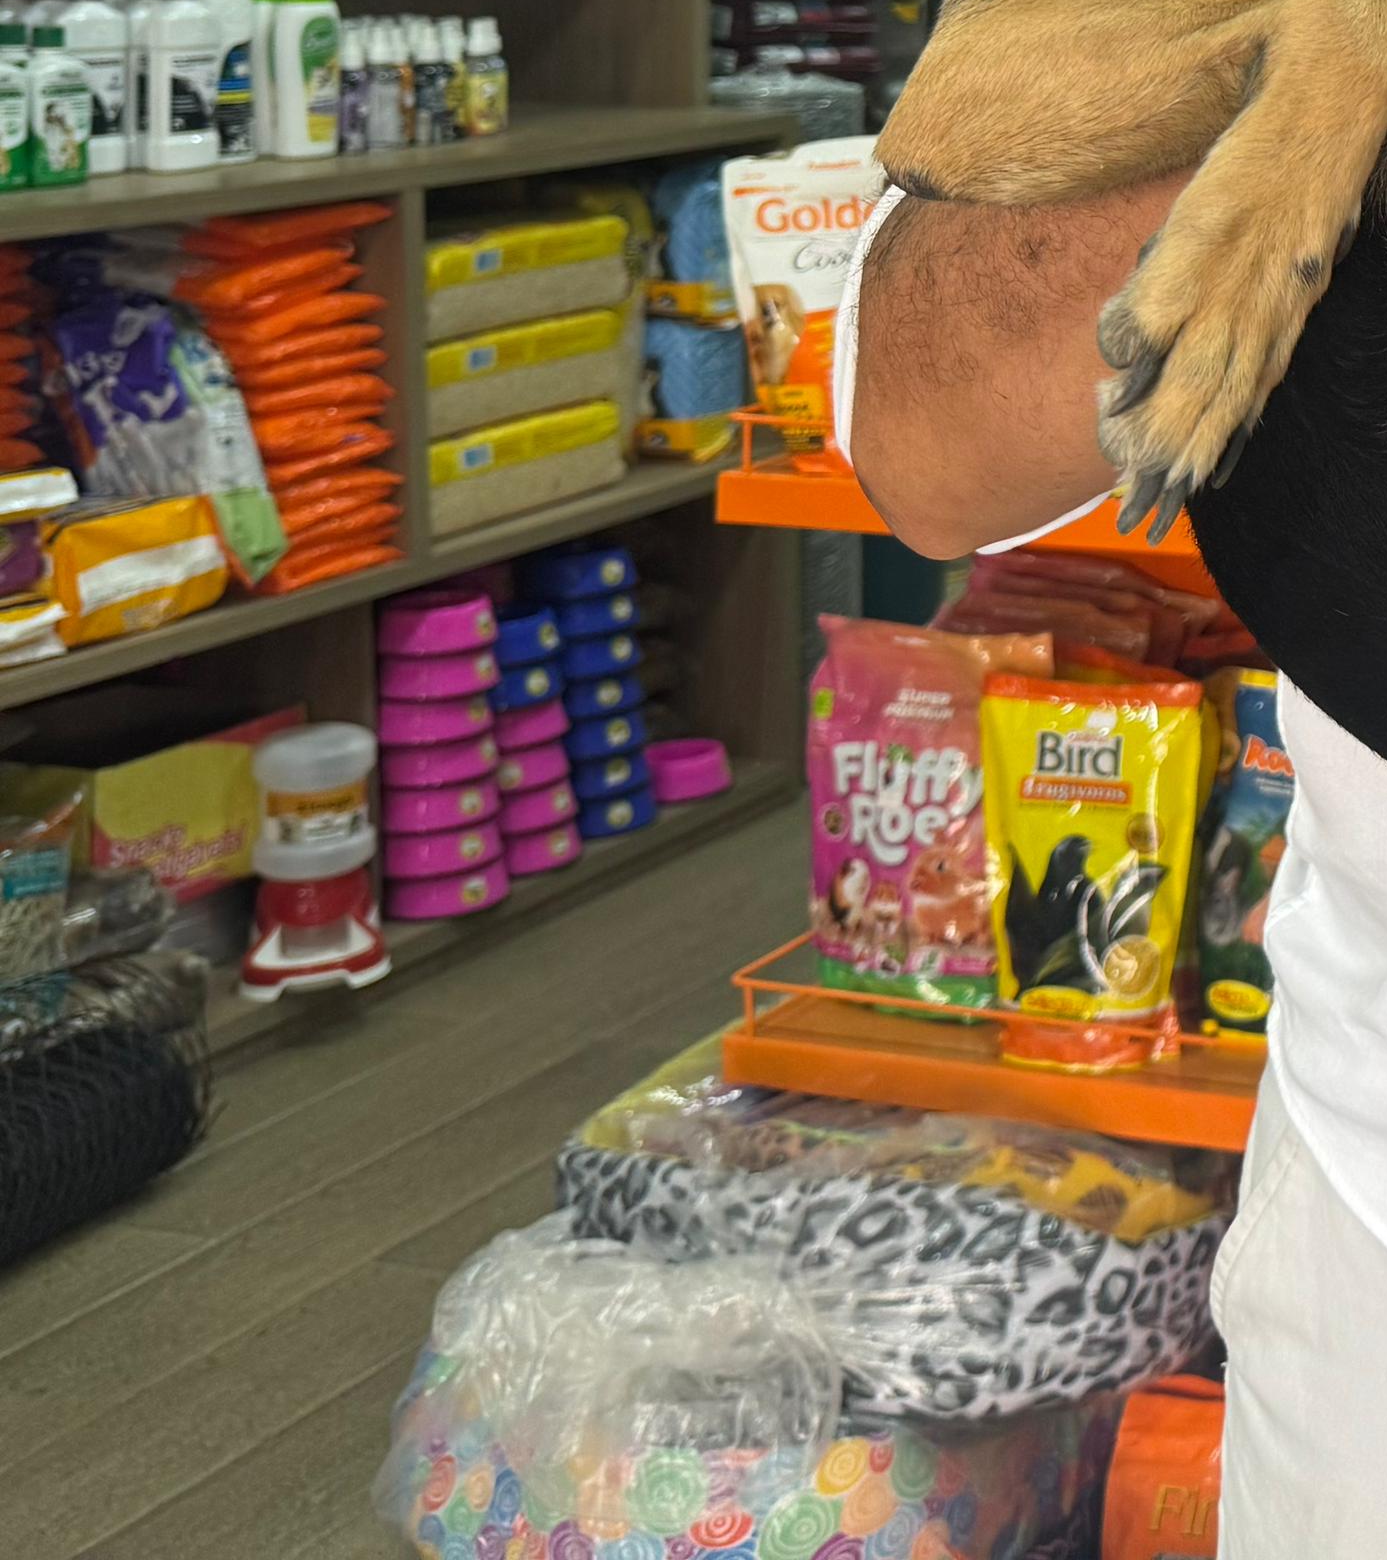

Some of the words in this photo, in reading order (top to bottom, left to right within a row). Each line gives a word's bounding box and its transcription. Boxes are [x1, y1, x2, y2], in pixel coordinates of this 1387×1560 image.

[833, 741, 984, 818] Fluffy
[1037, 731, 1123, 777] Bird
[851, 793, 949, 866] Roe
